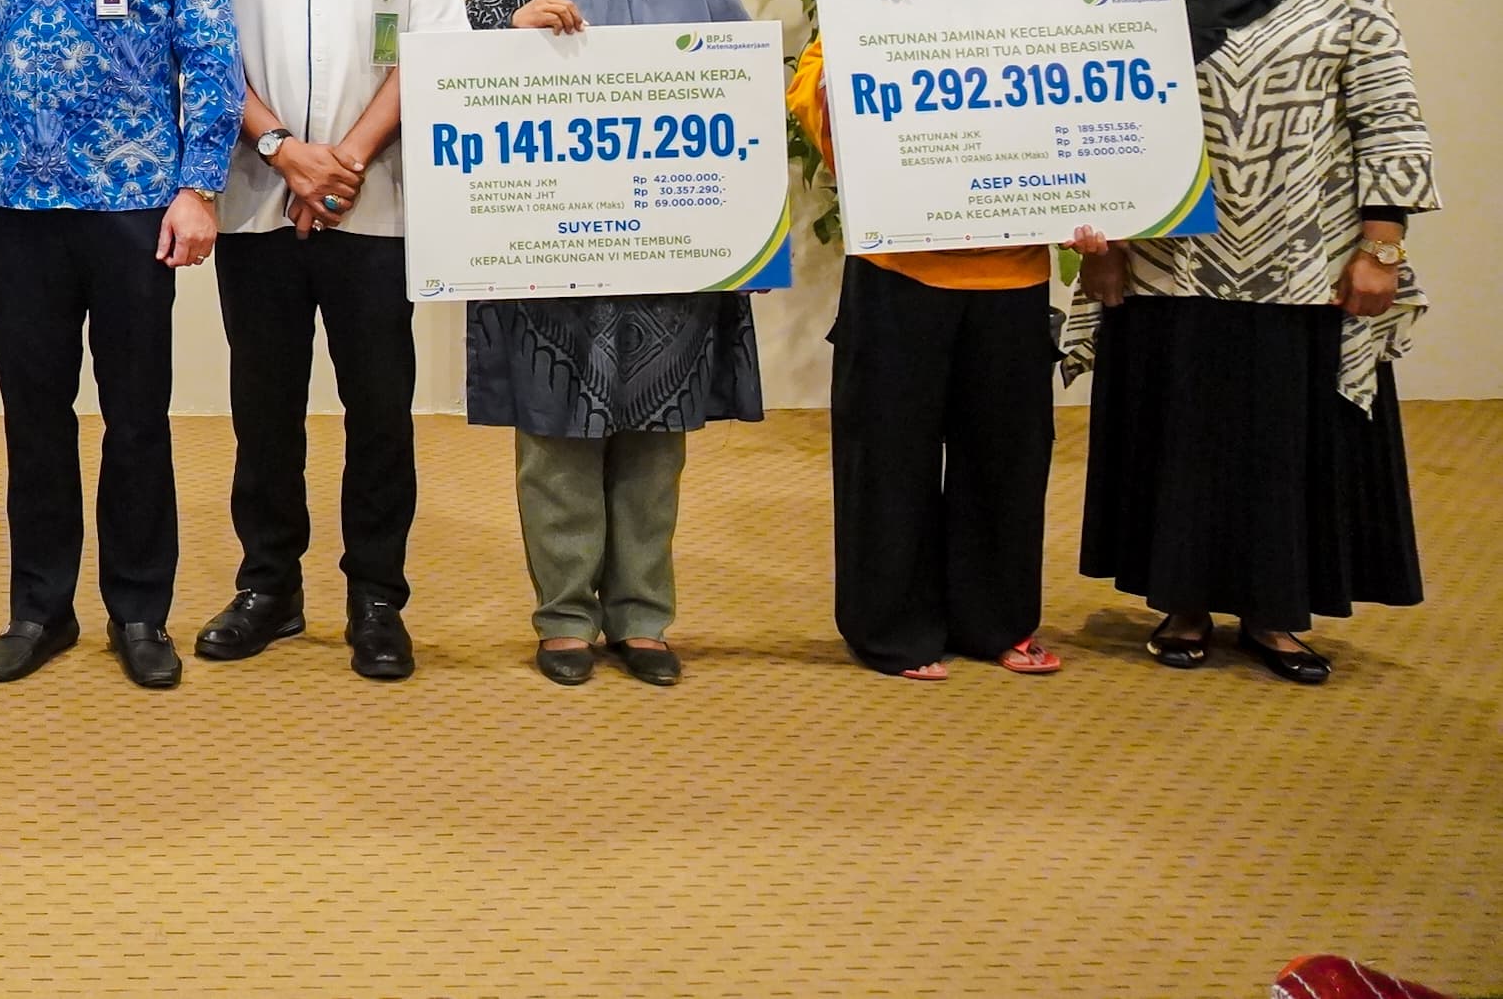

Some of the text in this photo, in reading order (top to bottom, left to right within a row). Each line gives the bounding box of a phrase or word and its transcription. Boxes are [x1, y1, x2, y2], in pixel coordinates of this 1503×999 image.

[706, 34, 733, 43] BPJS
[859, 21, 1158, 47] SANTUNAN JAMINAN KECELAKAAN KERJA,
[886, 39, 1135, 62] JAMINAN HARI TUA DAN BEASISWA
[437, 69, 752, 91] SANTUNAN JAMINAN KECELAKAAN KERJA,
[852, 57, 1178, 121] Rp 292.319.676,-
[464, 88, 726, 107] JAMINAN HARI TUA DAN BEASISWA
[898, 131, 981, 143] SANTUNAN JKK
[1055, 126, 1069, 135] Rp
[433, 113, 760, 173] Rp 141.357.290,-
[900, 142, 982, 155] SANTUNAN JHT
[1056, 138, 1070, 147] Rp
[901, 157, 952, 167] BEASISWA
[961, 154, 993, 163] ORANG
[995, 153, 1020, 161] ANAK
[1058, 150, 1072, 159] Rp
[470, 179, 557, 189] SANTUNAN JKM
[633, 173, 726, 185] Rp 42.000.000,-
[971, 173, 1086, 190] ASEP SOLIHIN
[470, 191, 555, 201] SANTUNAN JHT
[634, 185, 726, 197] Rp 30.357.290,-
[968, 190, 1090, 205] PEGAWAI NON ASN
[471, 205, 524, 214] BEASISWA
[533, 203, 567, 213] ORANG
[569, 202, 594, 211] ANAK
[596, 201, 625, 209] (Maks)
[634, 198, 726, 209] Rp 69.000.000,-
[927, 201, 1136, 221] PADA KECAMATAN MEDAN KOTA
[558, 220, 640, 233] SUYETNO
[510, 235, 691, 251] KECAMATAN MEDAN TEMBUNG
[470, 248, 732, 267] (KEPALA LINGKUNGAN VI MEDAN TEMBUNG)
